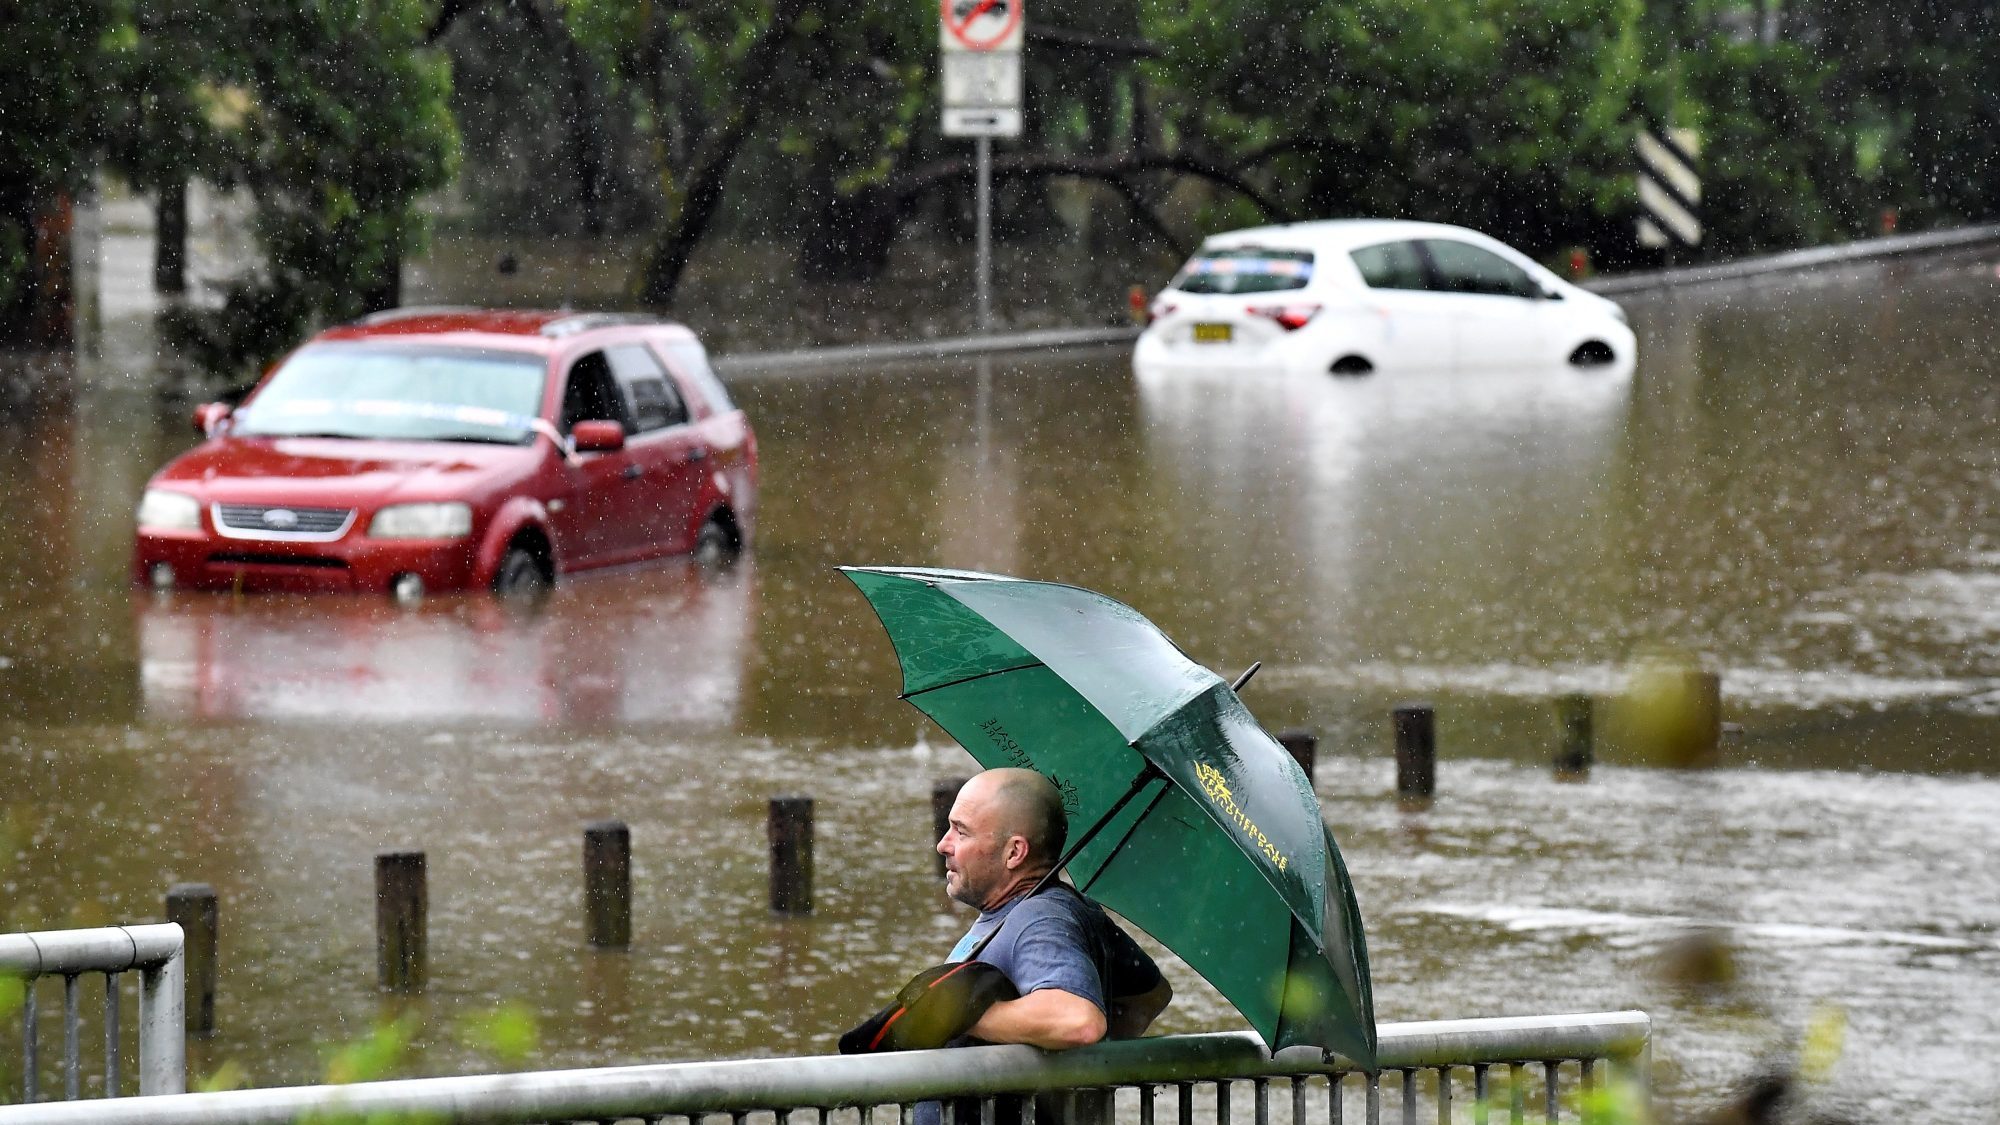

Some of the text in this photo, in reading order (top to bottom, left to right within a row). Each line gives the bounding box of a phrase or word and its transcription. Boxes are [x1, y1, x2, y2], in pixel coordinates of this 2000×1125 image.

[1205, 784, 1286, 873] WILDLIFE PARK
[1208, 777, 1288, 868] FEATHERDALE
